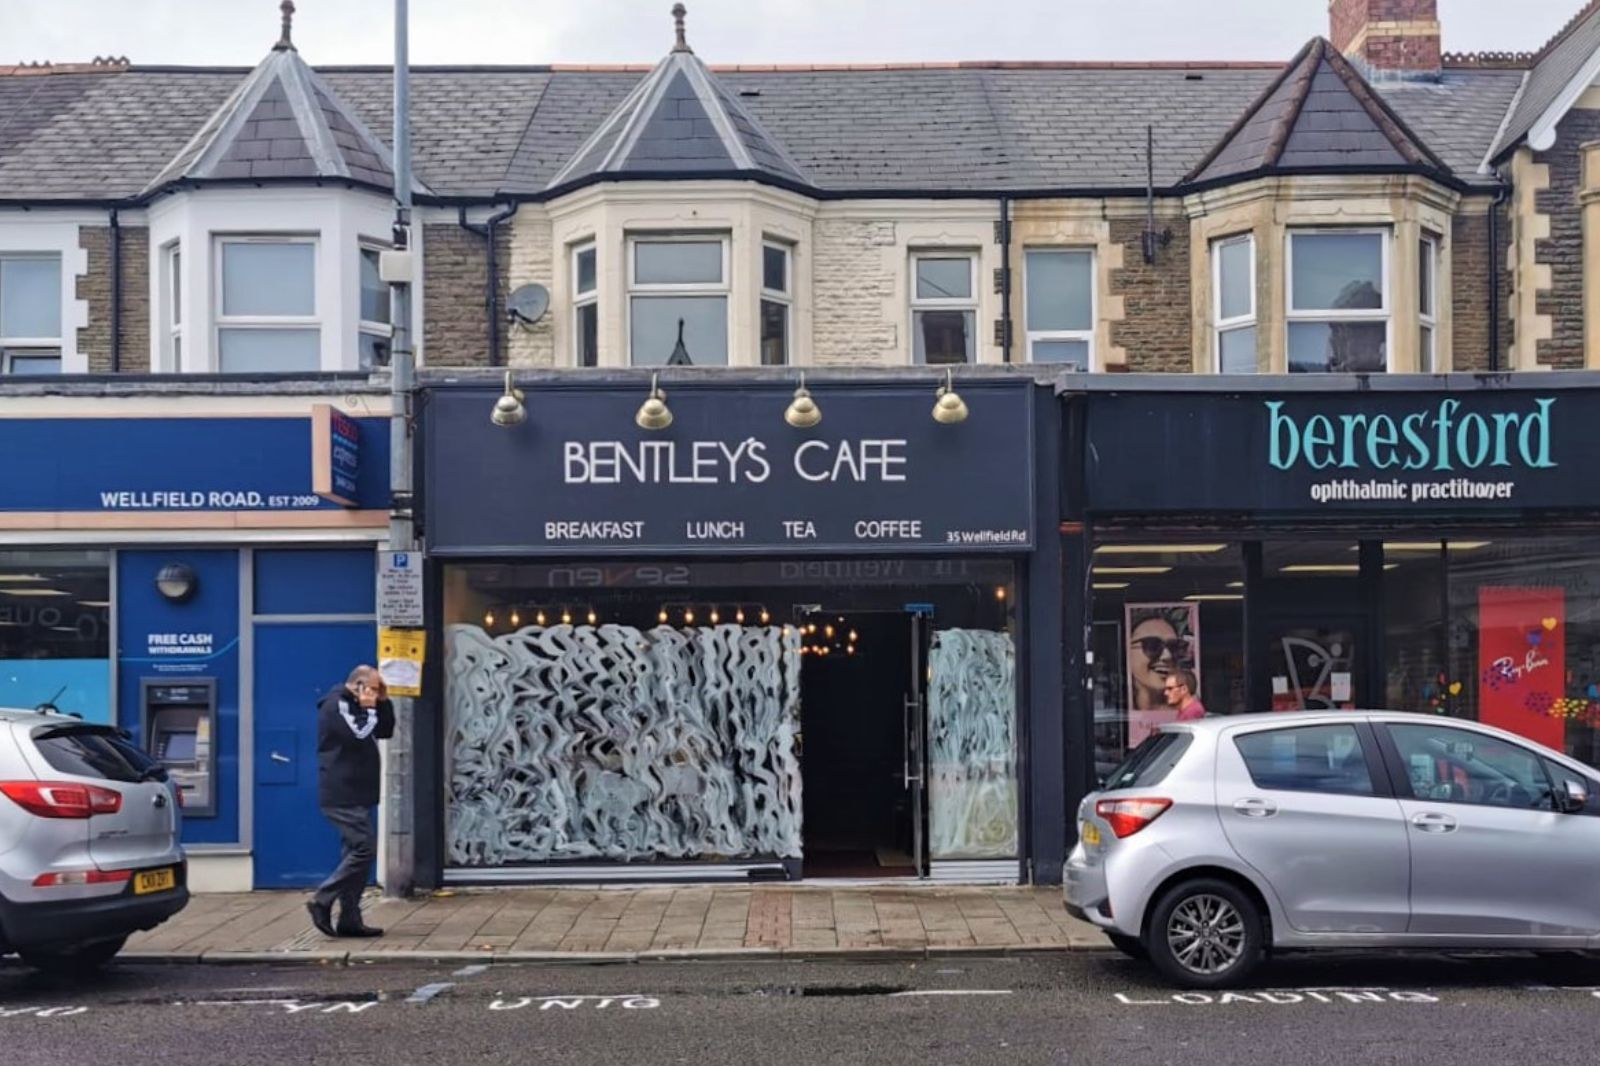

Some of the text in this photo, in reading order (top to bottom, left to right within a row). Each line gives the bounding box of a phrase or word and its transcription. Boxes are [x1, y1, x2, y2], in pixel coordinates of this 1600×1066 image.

[1264, 397, 1559, 471] beresford
[563, 436, 908, 484] BENTLEY'S CAFE
[100, 492, 205, 508] WELLFIELD
[268, 495, 289, 507] EST
[291, 495, 320, 507] 2009
[1310, 480, 1408, 502] ophthalmic
[544, 520, 922, 540] BREAKFAST LUNCH TEA COFFEE
[946, 529, 1027, 543] 35 Wellfield Rd
[148, 633, 213, 645] FREE CASH
[1114, 990, 1440, 1005] LOADING
